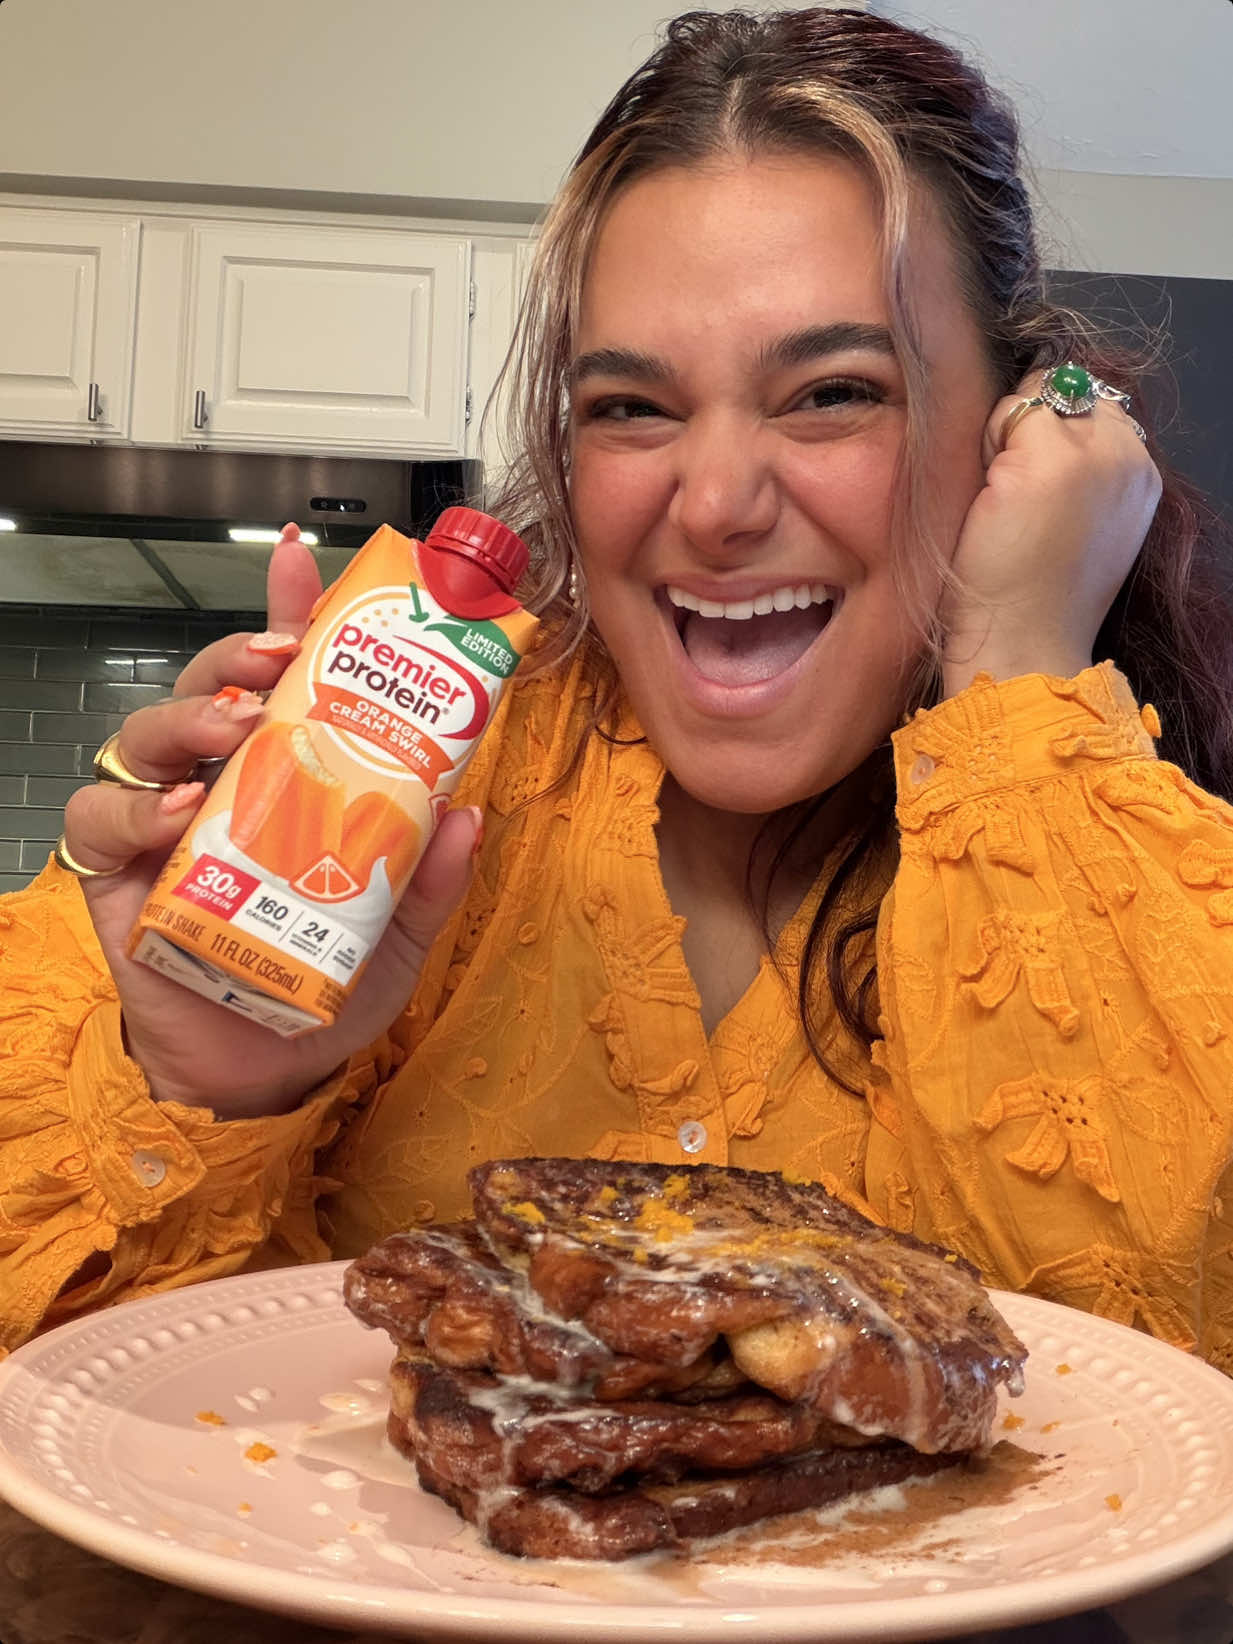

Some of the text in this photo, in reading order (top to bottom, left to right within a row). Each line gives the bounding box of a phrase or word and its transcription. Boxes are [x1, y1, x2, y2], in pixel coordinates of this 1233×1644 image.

[332, 624, 467, 705] premier
[460, 637, 510, 675] EDITION
[466, 628, 513, 665] LIMITED
[328, 651, 440, 725] protein
[329, 701, 386, 736] CREAM
[388, 731, 432, 769] SWIRL
[356, 700, 423, 745] ORANGE
[184, 883, 233, 911] PROTEIN
[196, 865, 242, 899] 30g
[255, 895, 288, 921] 160
[302, 921, 329, 943] 24
[172, 914, 206, 942] SHAKE
[210, 933, 223, 953] 11
[223, 940, 240, 961] FL
[239, 947, 260, 968] OZ
[255, 953, 304, 995] (325mL)
